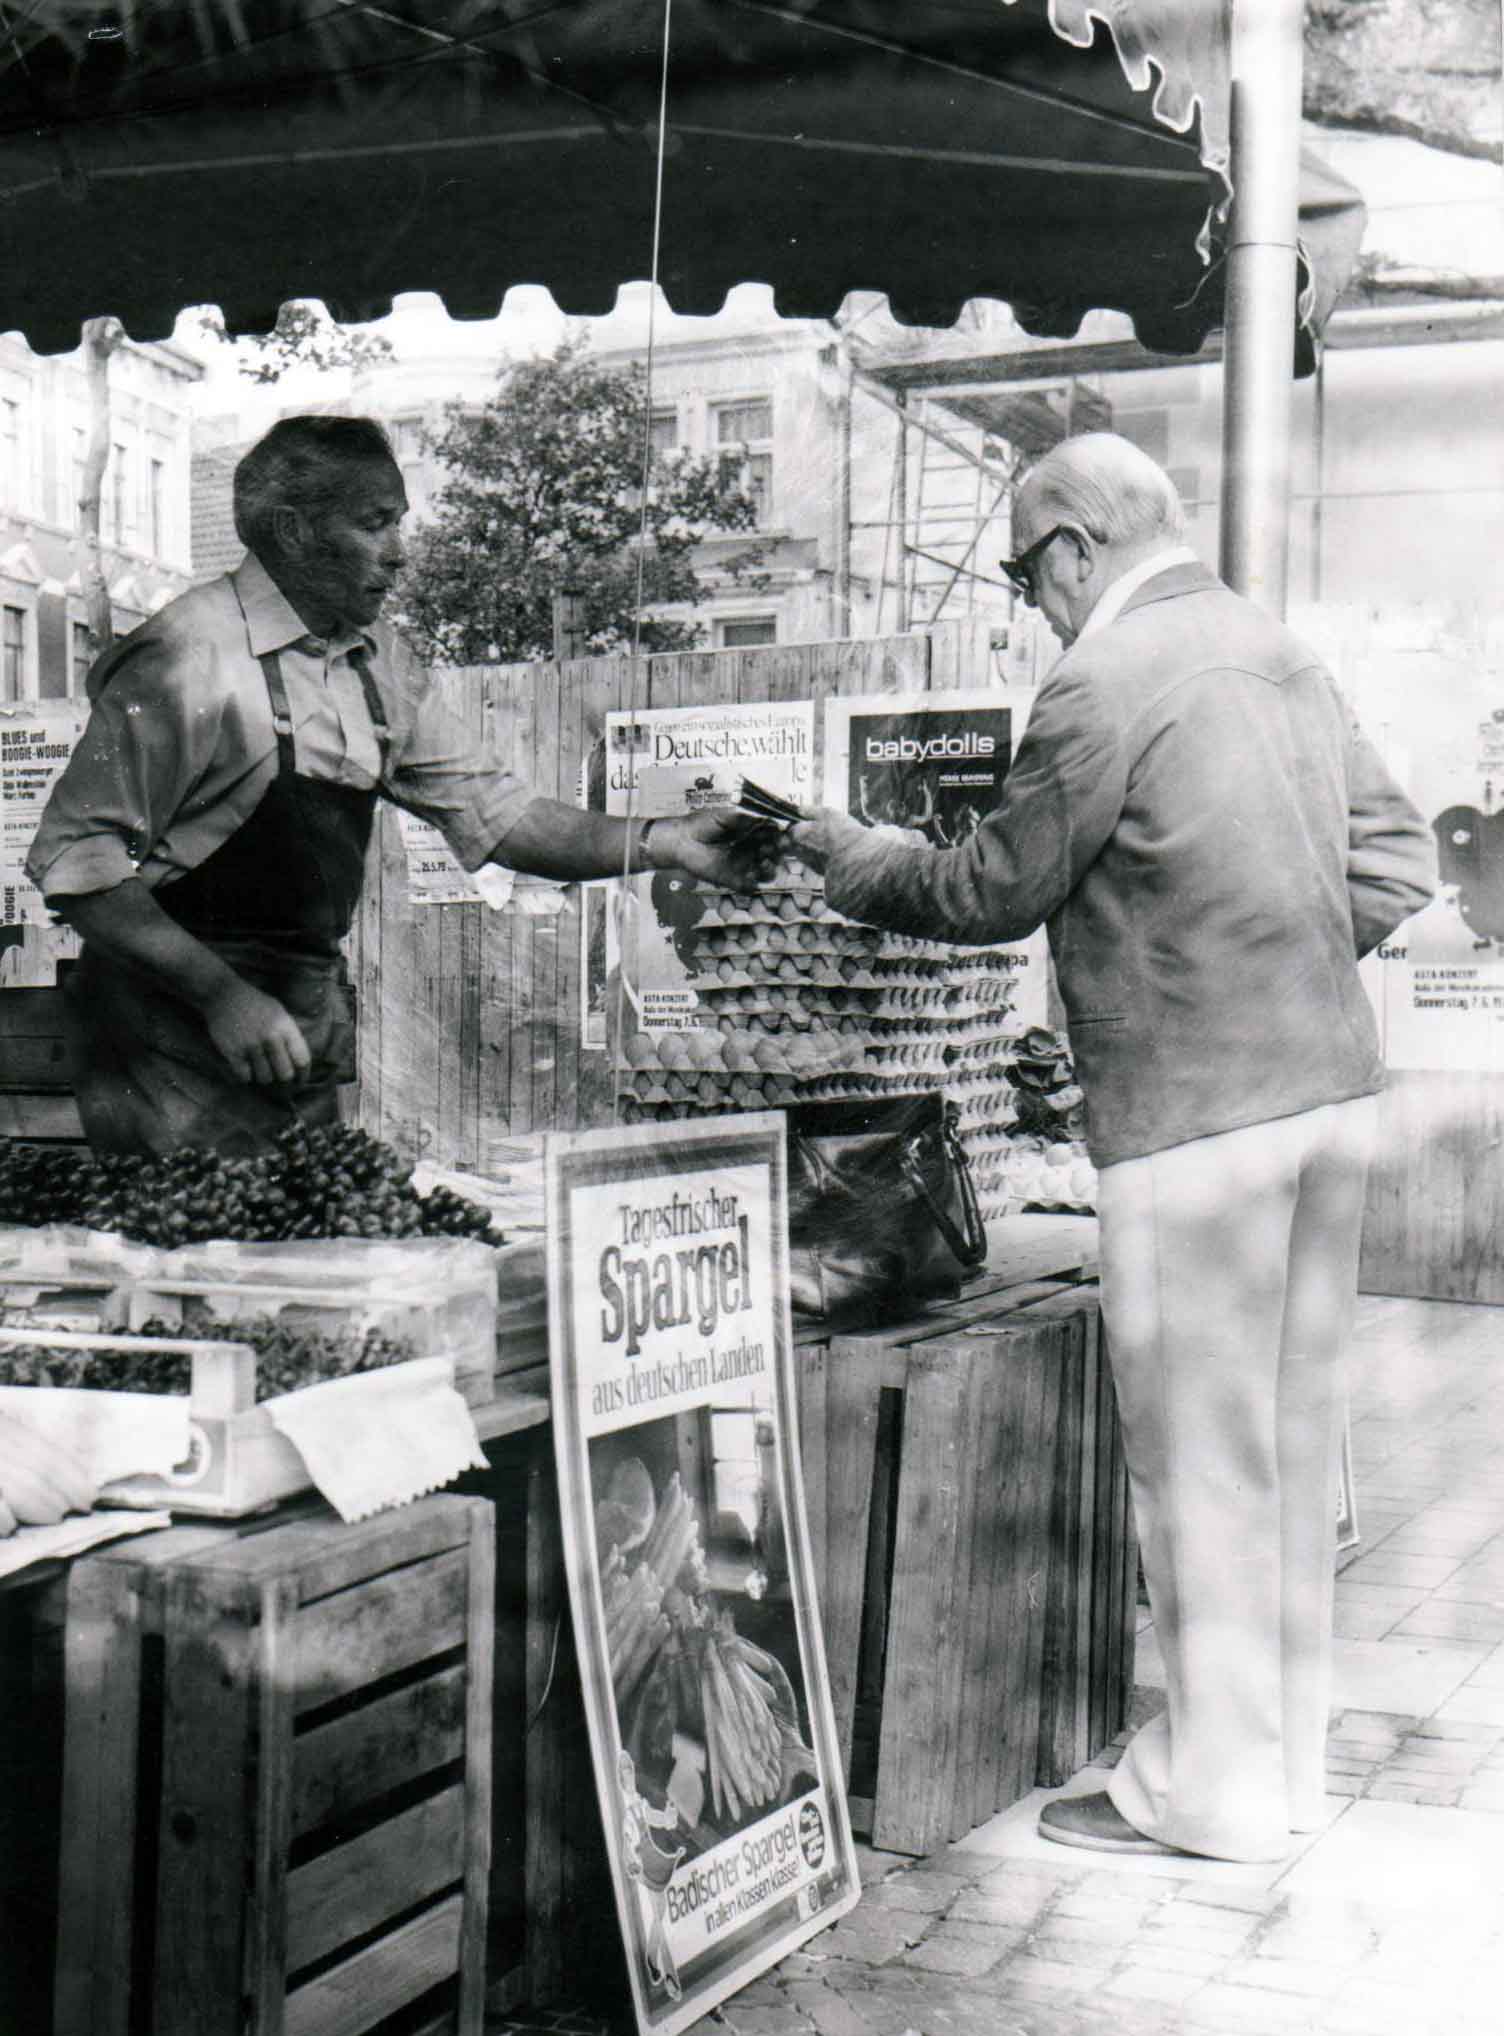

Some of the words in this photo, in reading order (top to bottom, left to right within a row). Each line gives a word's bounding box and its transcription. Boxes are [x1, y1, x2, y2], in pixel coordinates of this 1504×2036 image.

[2, 730, 27, 745] BLUES
[2, 744, 69, 761] BOOGIE-WOOGIE
[751, 728, 806, 754] wählt
[866, 732, 995, 762] babydolls
[619, 1187, 738, 1247] Tagesfrischer
[600, 1214, 752, 1357] Spargel
[592, 1377, 624, 1415] aus
[626, 1352, 708, 1406] deutschen
[709, 1336, 766, 1385] Landen
[666, 1853, 740, 1923] Badischer
[741, 1813, 798, 1878] Spargel
